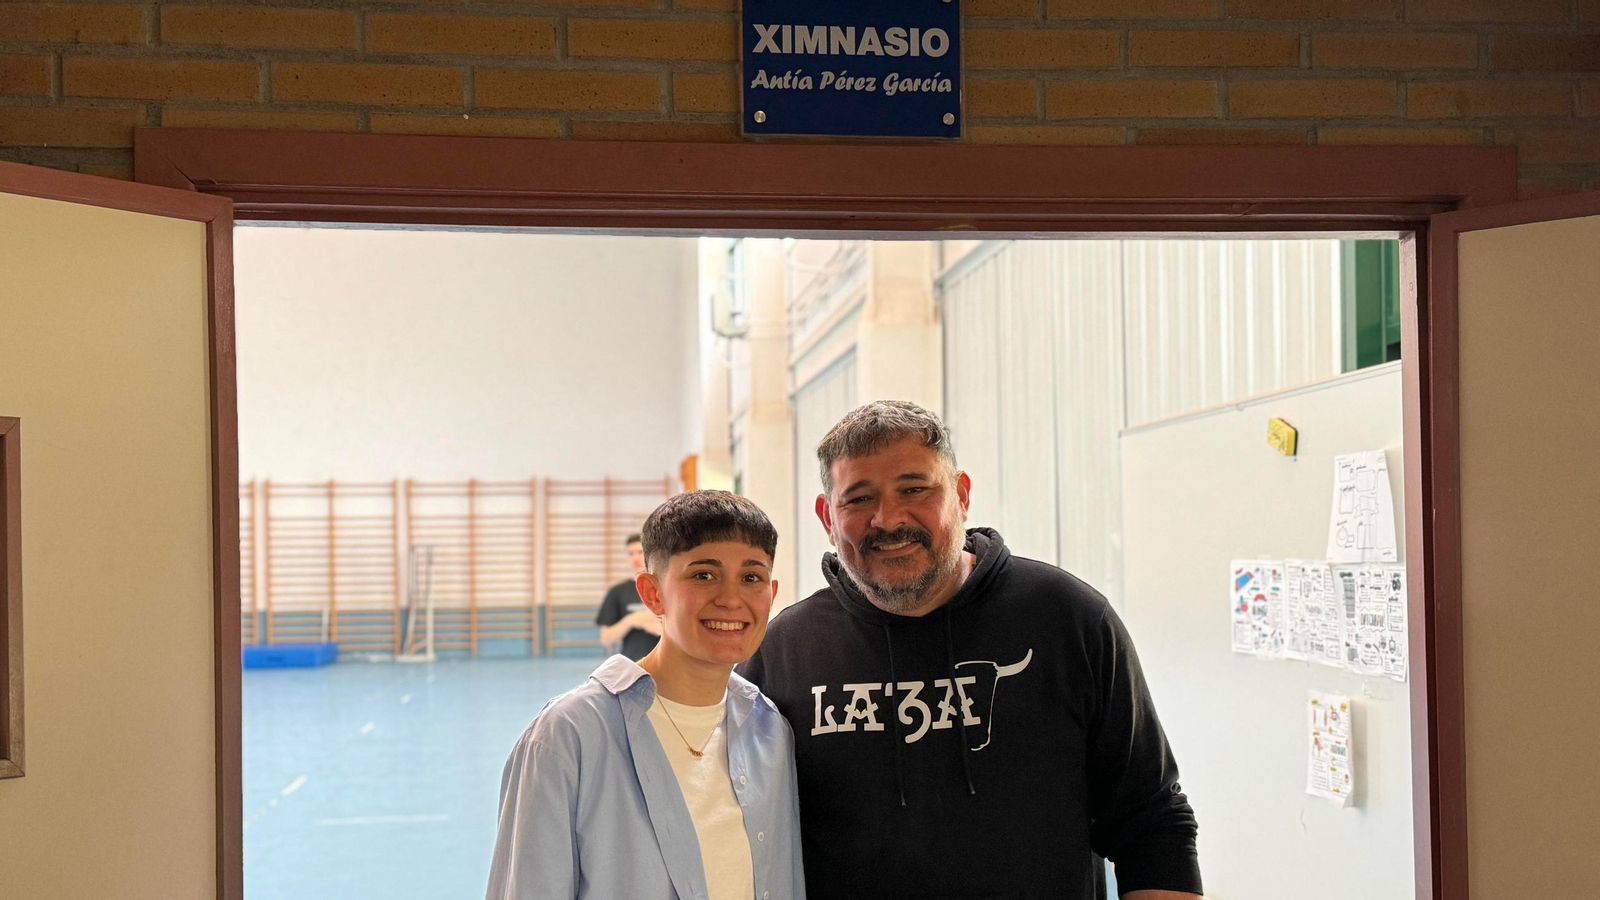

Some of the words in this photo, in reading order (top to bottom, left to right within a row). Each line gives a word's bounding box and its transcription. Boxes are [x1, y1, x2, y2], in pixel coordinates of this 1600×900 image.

[752, 23, 950, 58] XIMNASIO
[751, 69, 813, 91] Antía
[819, 70, 877, 92] Pérez
[883, 72, 953, 96] García
